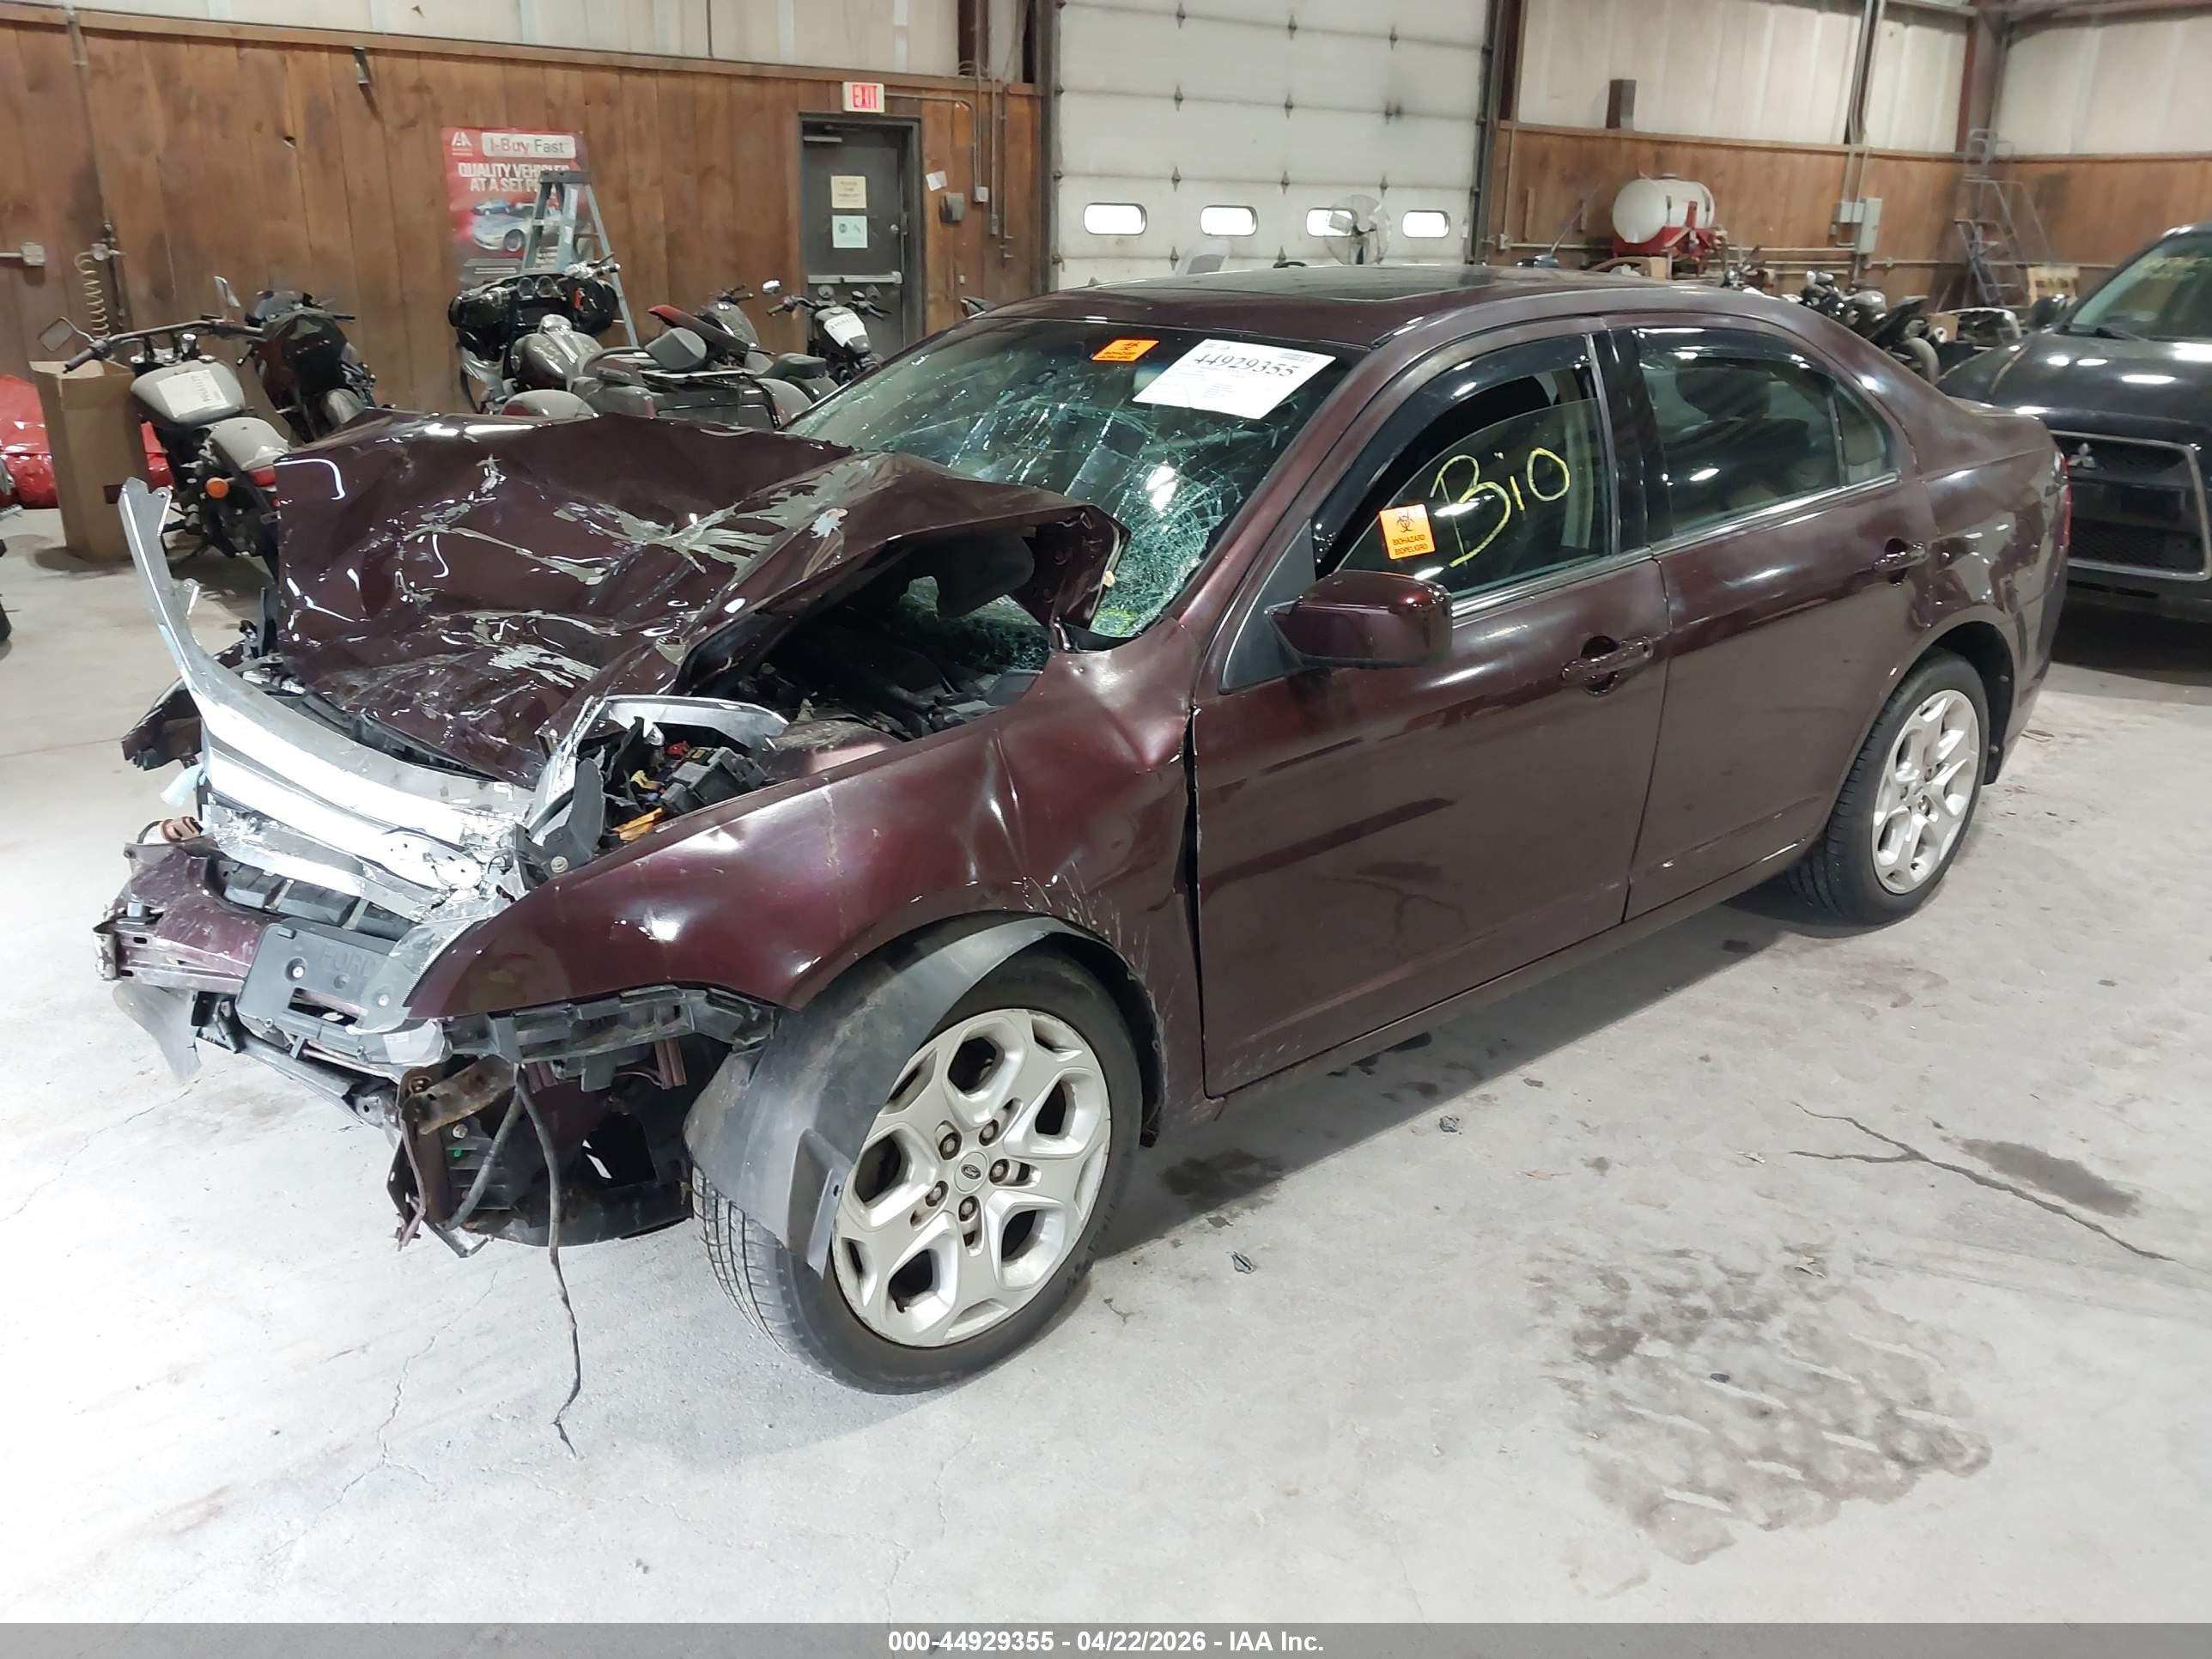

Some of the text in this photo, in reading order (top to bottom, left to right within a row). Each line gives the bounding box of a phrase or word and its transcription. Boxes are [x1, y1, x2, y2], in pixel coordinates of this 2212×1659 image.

[851, 84, 878, 109] EXIT
[490, 137, 530, 153] I-Buy
[459, 162, 511, 177] QUALITY
[470, 177, 487, 192] AT
[488, 177, 498, 192] A
[500, 178, 524, 193] SET
[1194, 354, 1299, 376] 44929355
